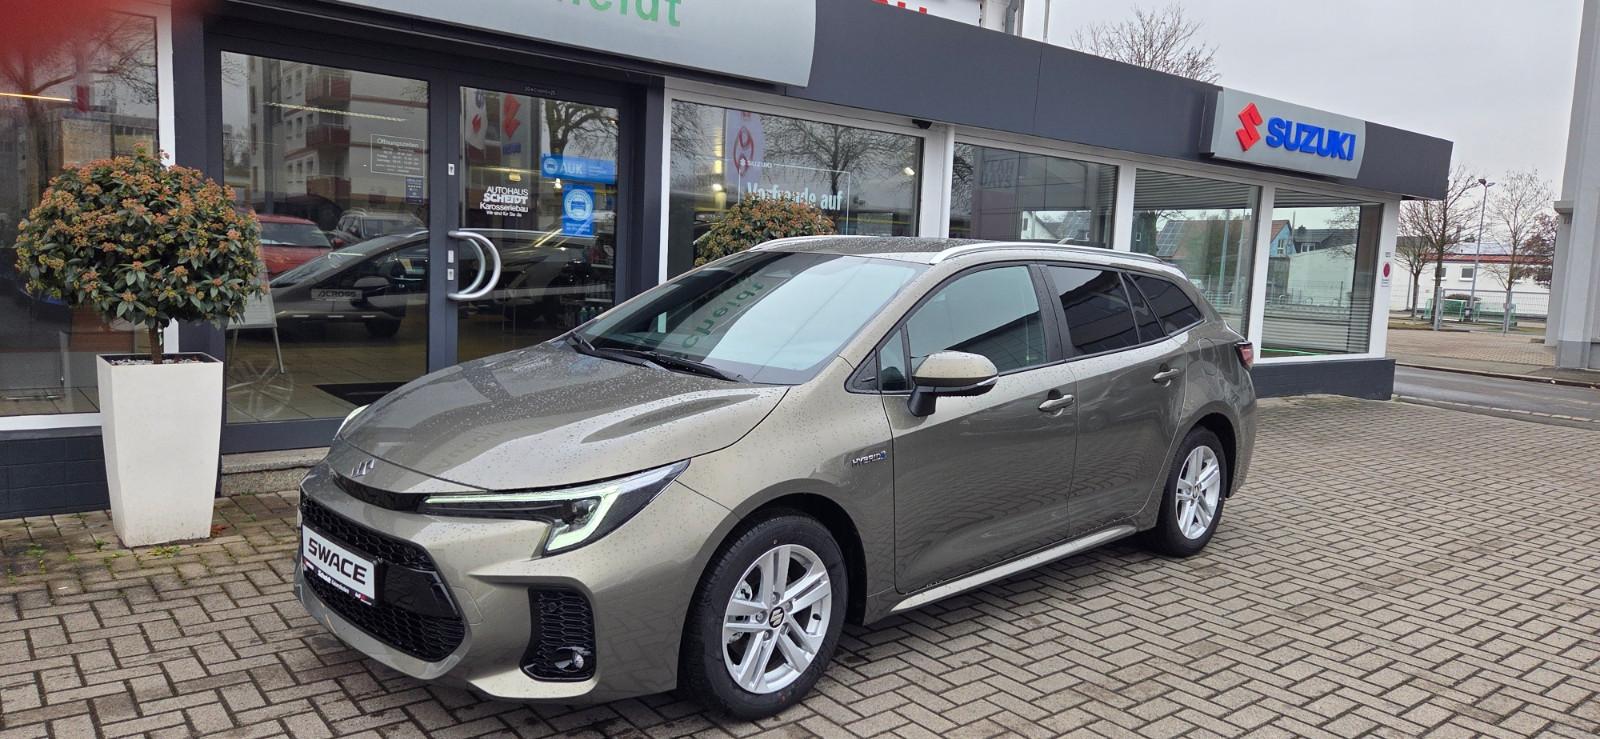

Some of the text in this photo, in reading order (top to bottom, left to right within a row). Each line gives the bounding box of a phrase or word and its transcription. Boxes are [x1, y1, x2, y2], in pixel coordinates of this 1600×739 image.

[1265, 117, 1356, 161] SUZUKI
[486, 185, 529, 196] AUTOHAUS
[483, 193, 529, 205] SCHEIDT
[820, 189, 843, 211] auf
[479, 201, 529, 213] Karosseriebau
[318, 290, 357, 298] ACROSS
[308, 537, 367, 585] SWACE
